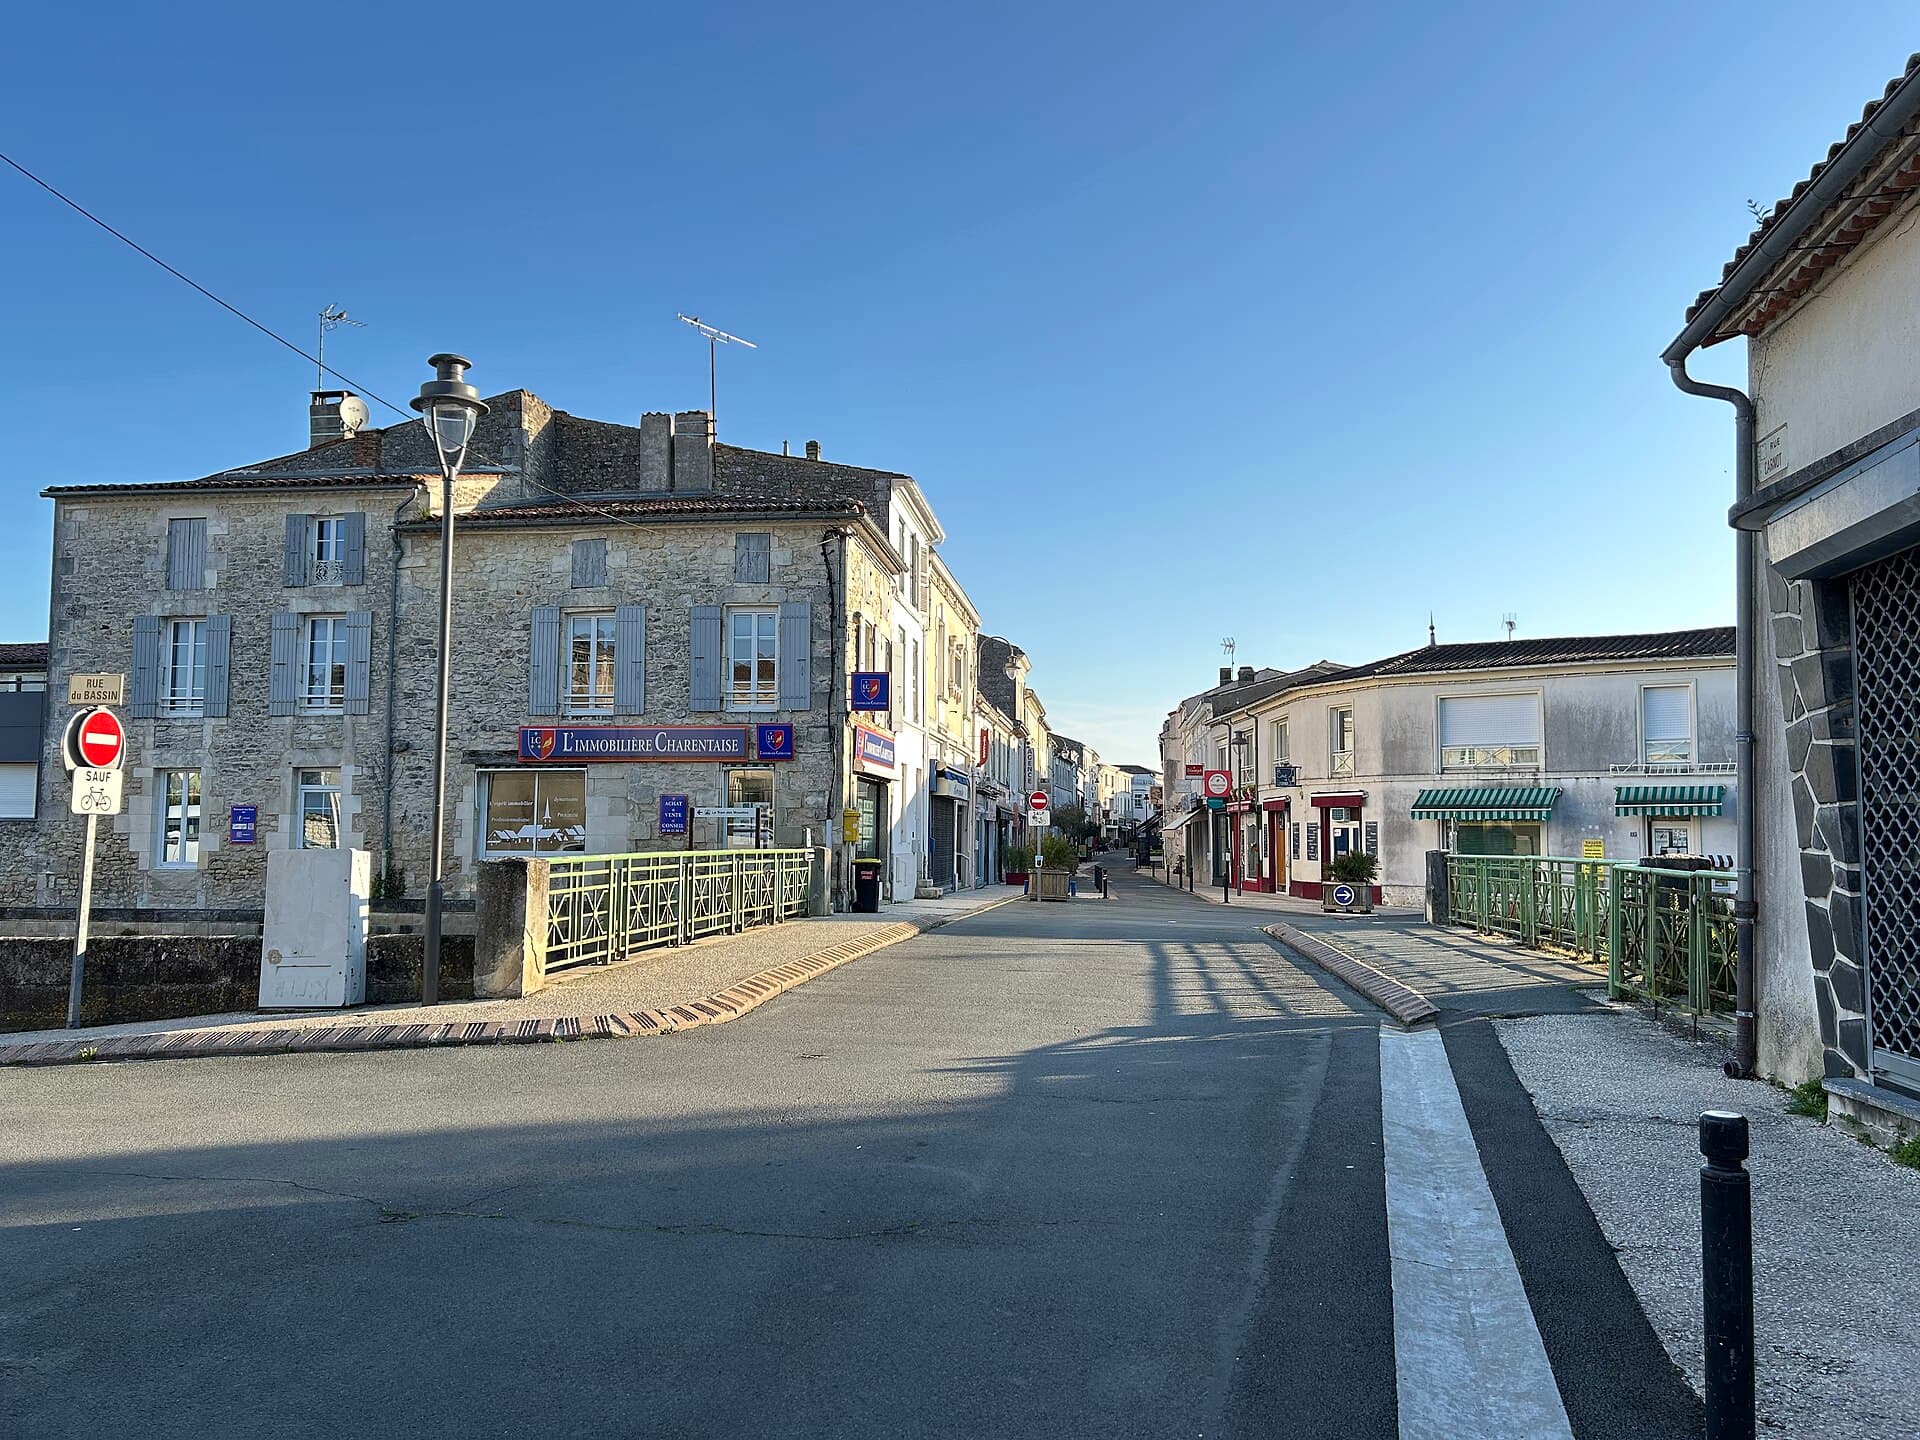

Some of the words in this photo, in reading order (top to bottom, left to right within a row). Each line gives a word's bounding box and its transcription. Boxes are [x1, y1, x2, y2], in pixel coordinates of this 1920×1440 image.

[86, 679, 104, 688] RUE
[71, 691, 82, 700] du
[84, 691, 118, 700] BASSIN
[562, 732, 653, 752] L'IMMOBILIÈRE
[654, 731, 739, 752] CHARENTAISE
[85, 770, 112, 782] SAUF
